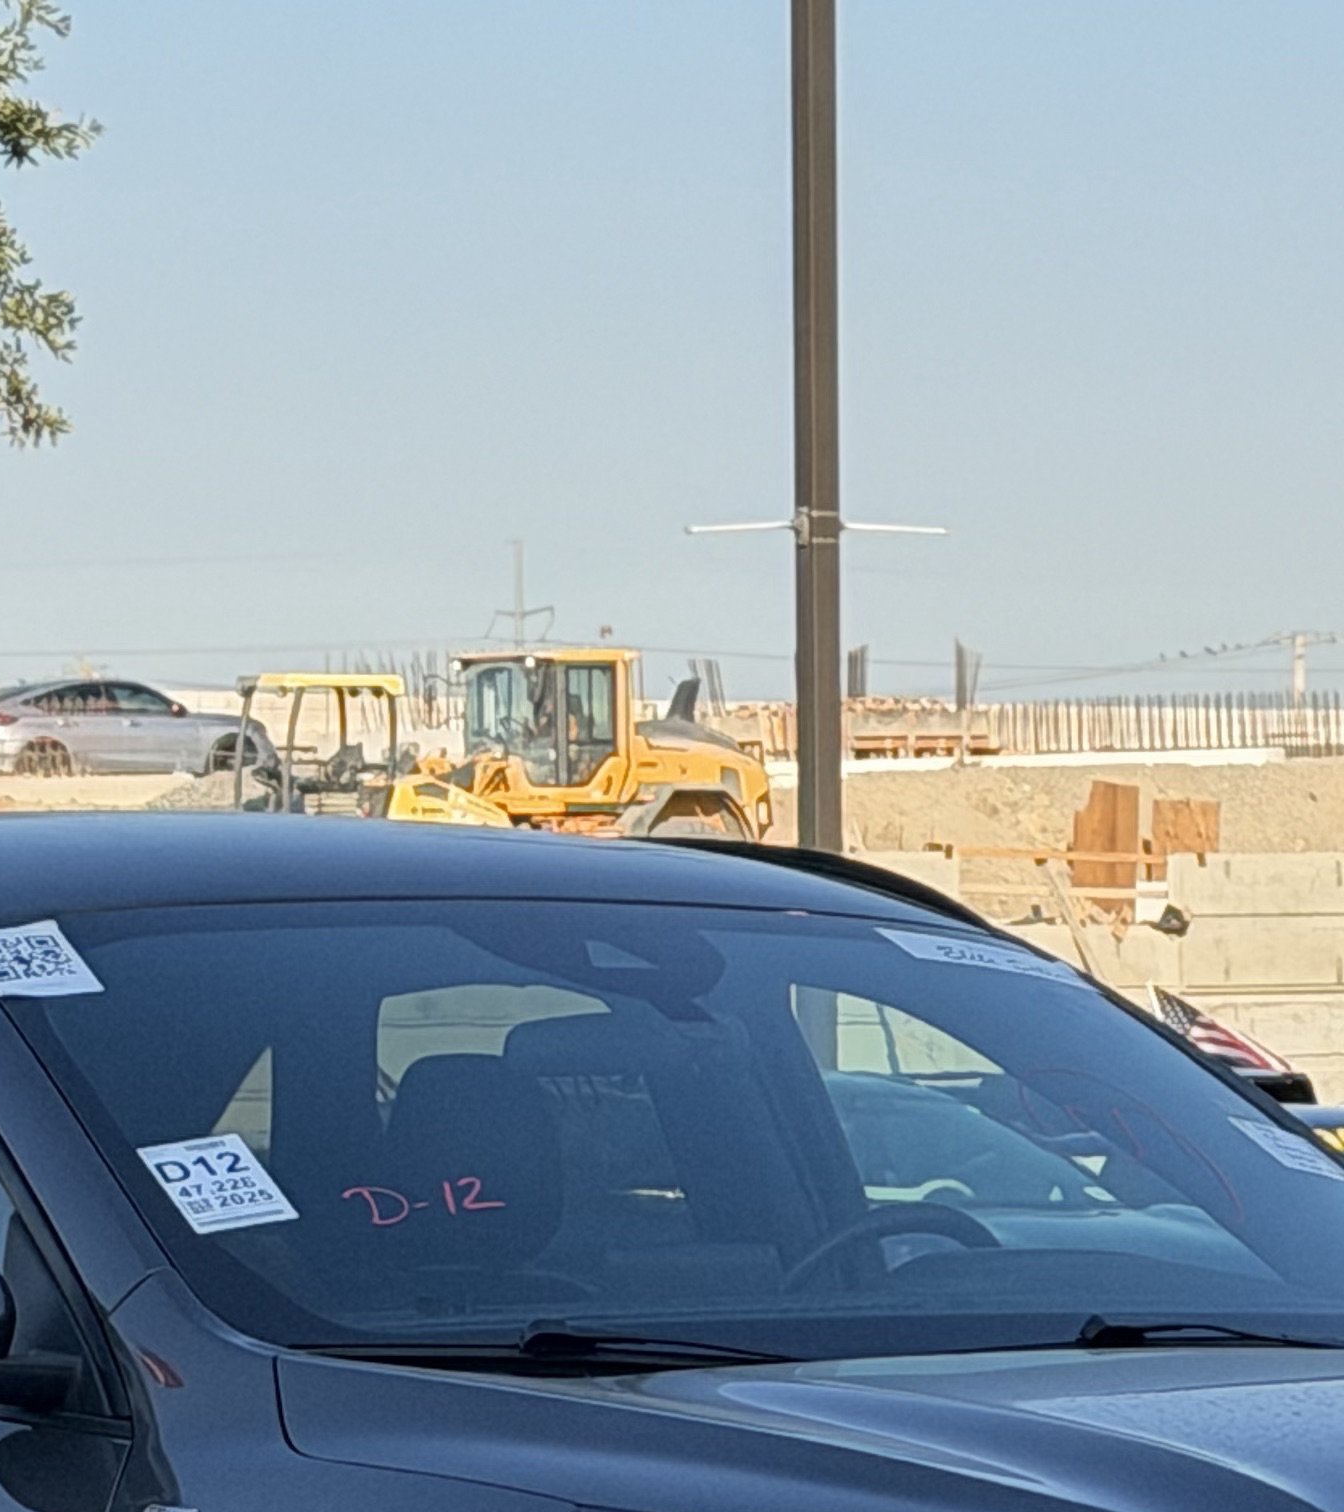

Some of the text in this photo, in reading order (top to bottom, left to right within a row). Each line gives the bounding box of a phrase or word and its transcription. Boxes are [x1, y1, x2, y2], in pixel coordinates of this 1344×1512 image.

[154, 1152, 250, 1183] D12
[214, 1189, 274, 1208] 2025
[342, 1176, 506, 1225] D-12
